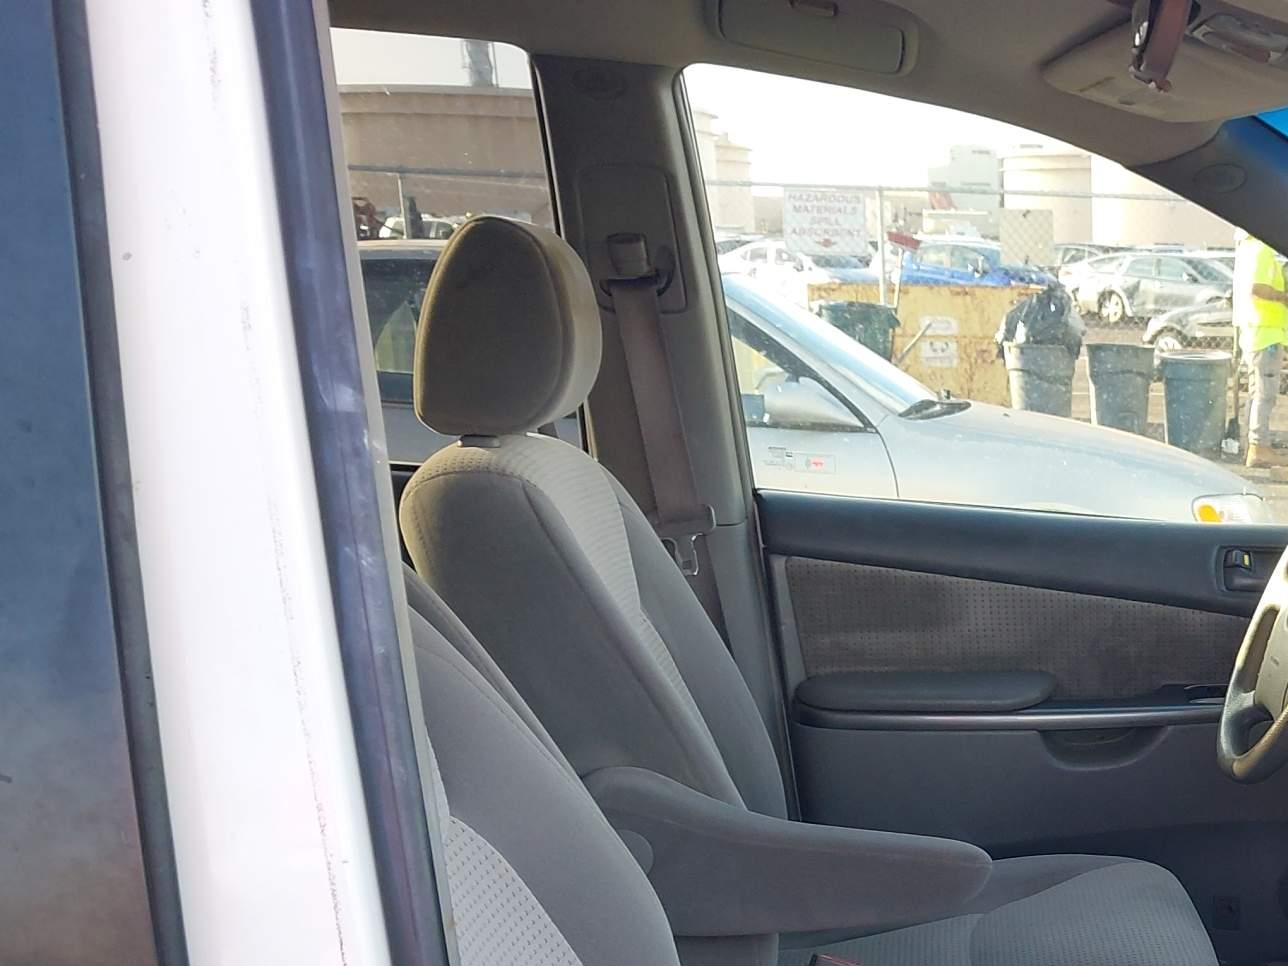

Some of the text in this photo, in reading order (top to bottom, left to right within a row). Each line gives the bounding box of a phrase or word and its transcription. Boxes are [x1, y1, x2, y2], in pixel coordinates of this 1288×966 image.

[788, 192, 861, 204] HAZARDOUS
[792, 204, 857, 215] MATERIALS
[809, 215, 841, 226] SPILL
[790, 226, 861, 238] ABSORBENT
